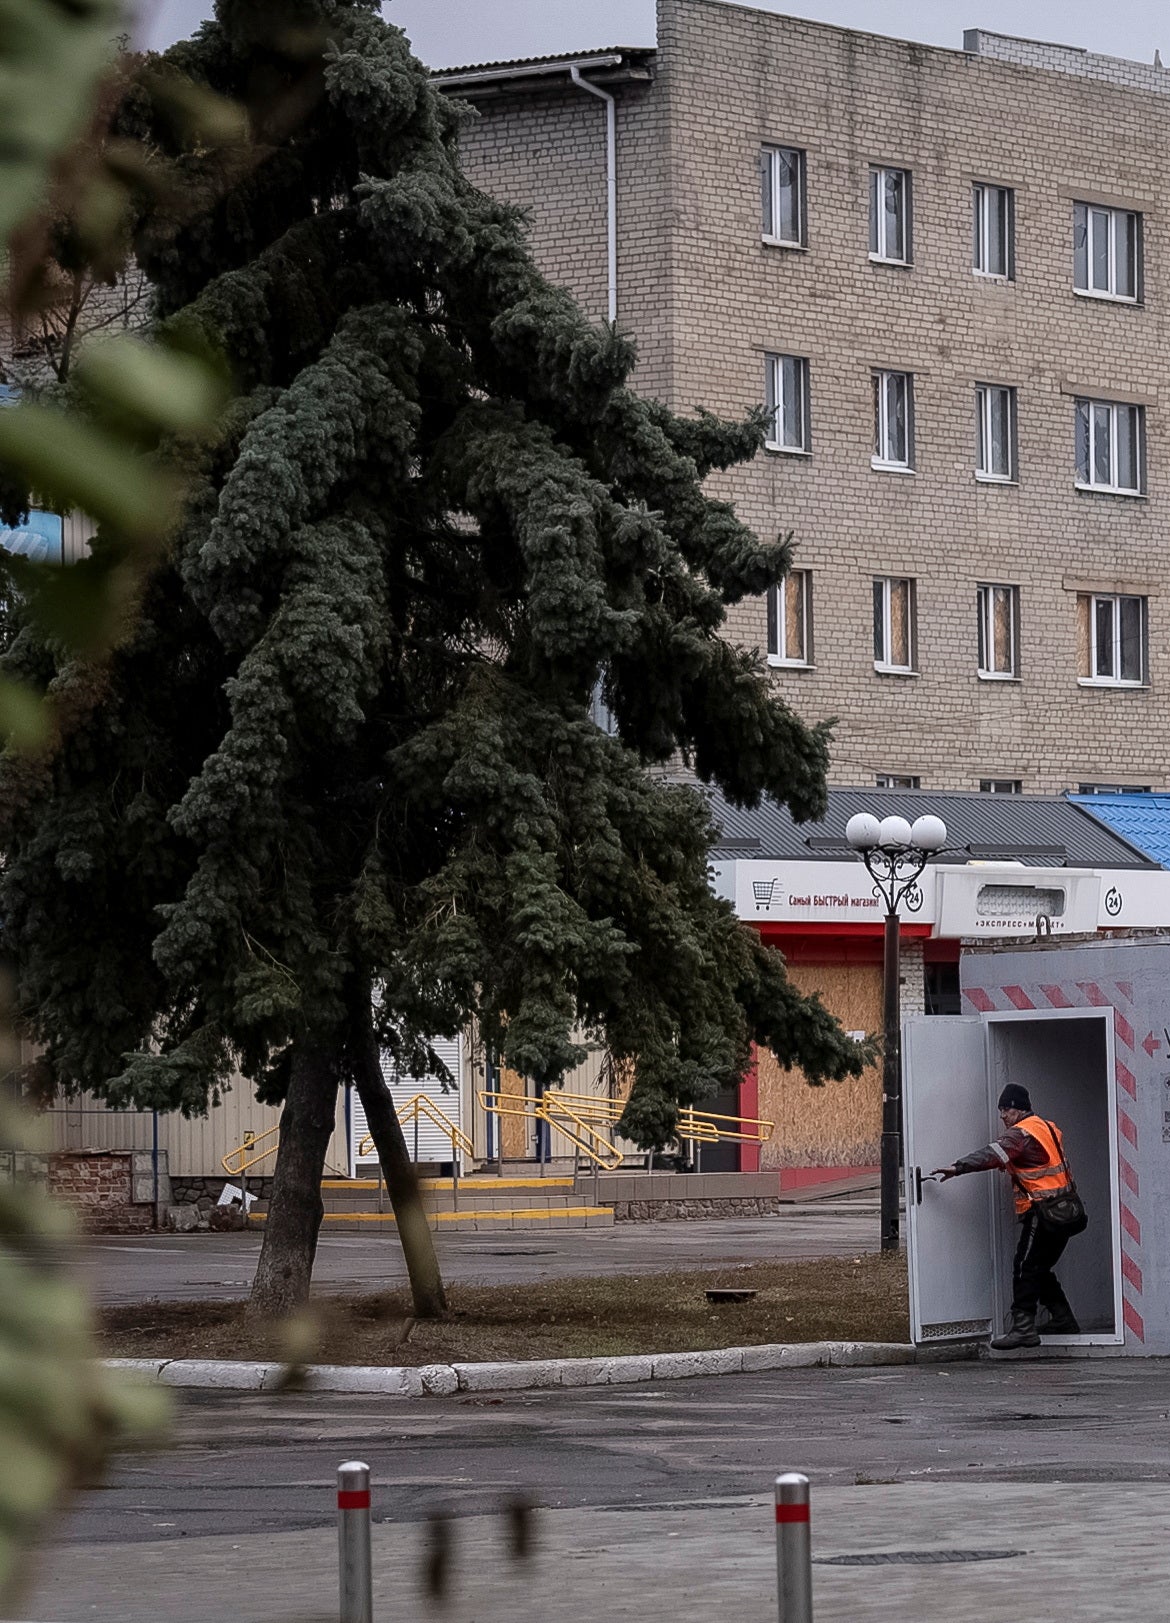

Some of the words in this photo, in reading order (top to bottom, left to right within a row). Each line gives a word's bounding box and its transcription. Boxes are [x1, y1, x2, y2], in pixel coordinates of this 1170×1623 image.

[788, 894, 812, 906] Самый
[813, 893, 849, 907] БЫСТРЫЙ
[1108, 897, 1119, 909] 24
